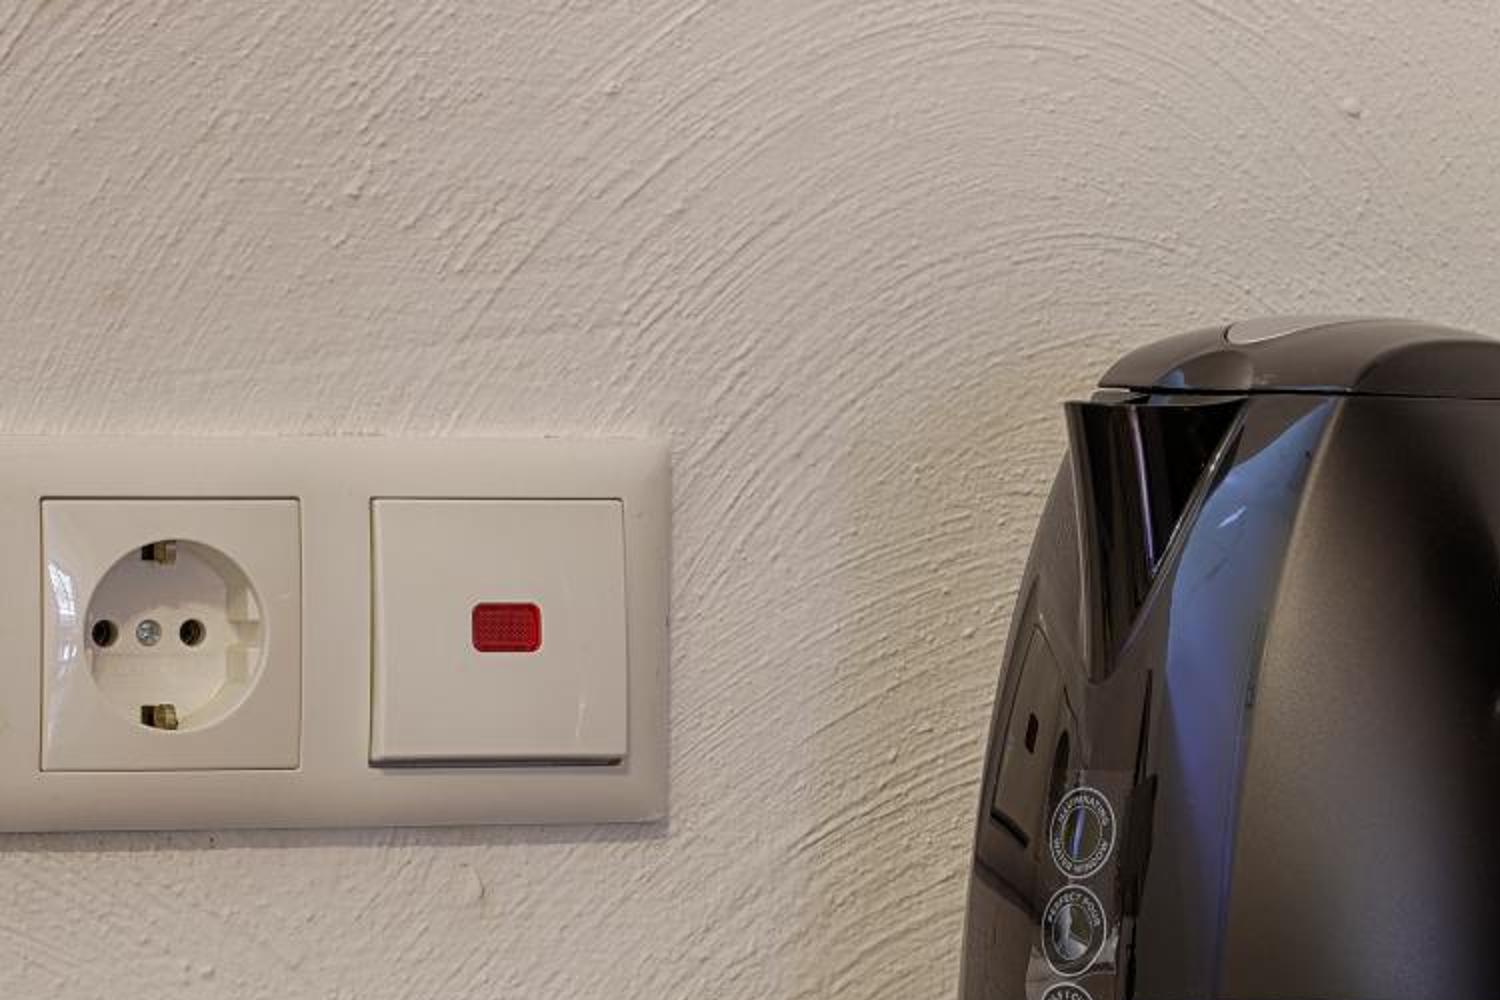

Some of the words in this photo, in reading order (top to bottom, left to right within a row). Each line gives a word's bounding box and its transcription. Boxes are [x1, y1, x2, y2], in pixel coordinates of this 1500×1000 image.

[1054, 837, 1073, 871] WATER
[1074, 841, 1110, 874] WINDOW
[1048, 892, 1082, 922] PERFECT
[1083, 896, 1102, 928] POUR
